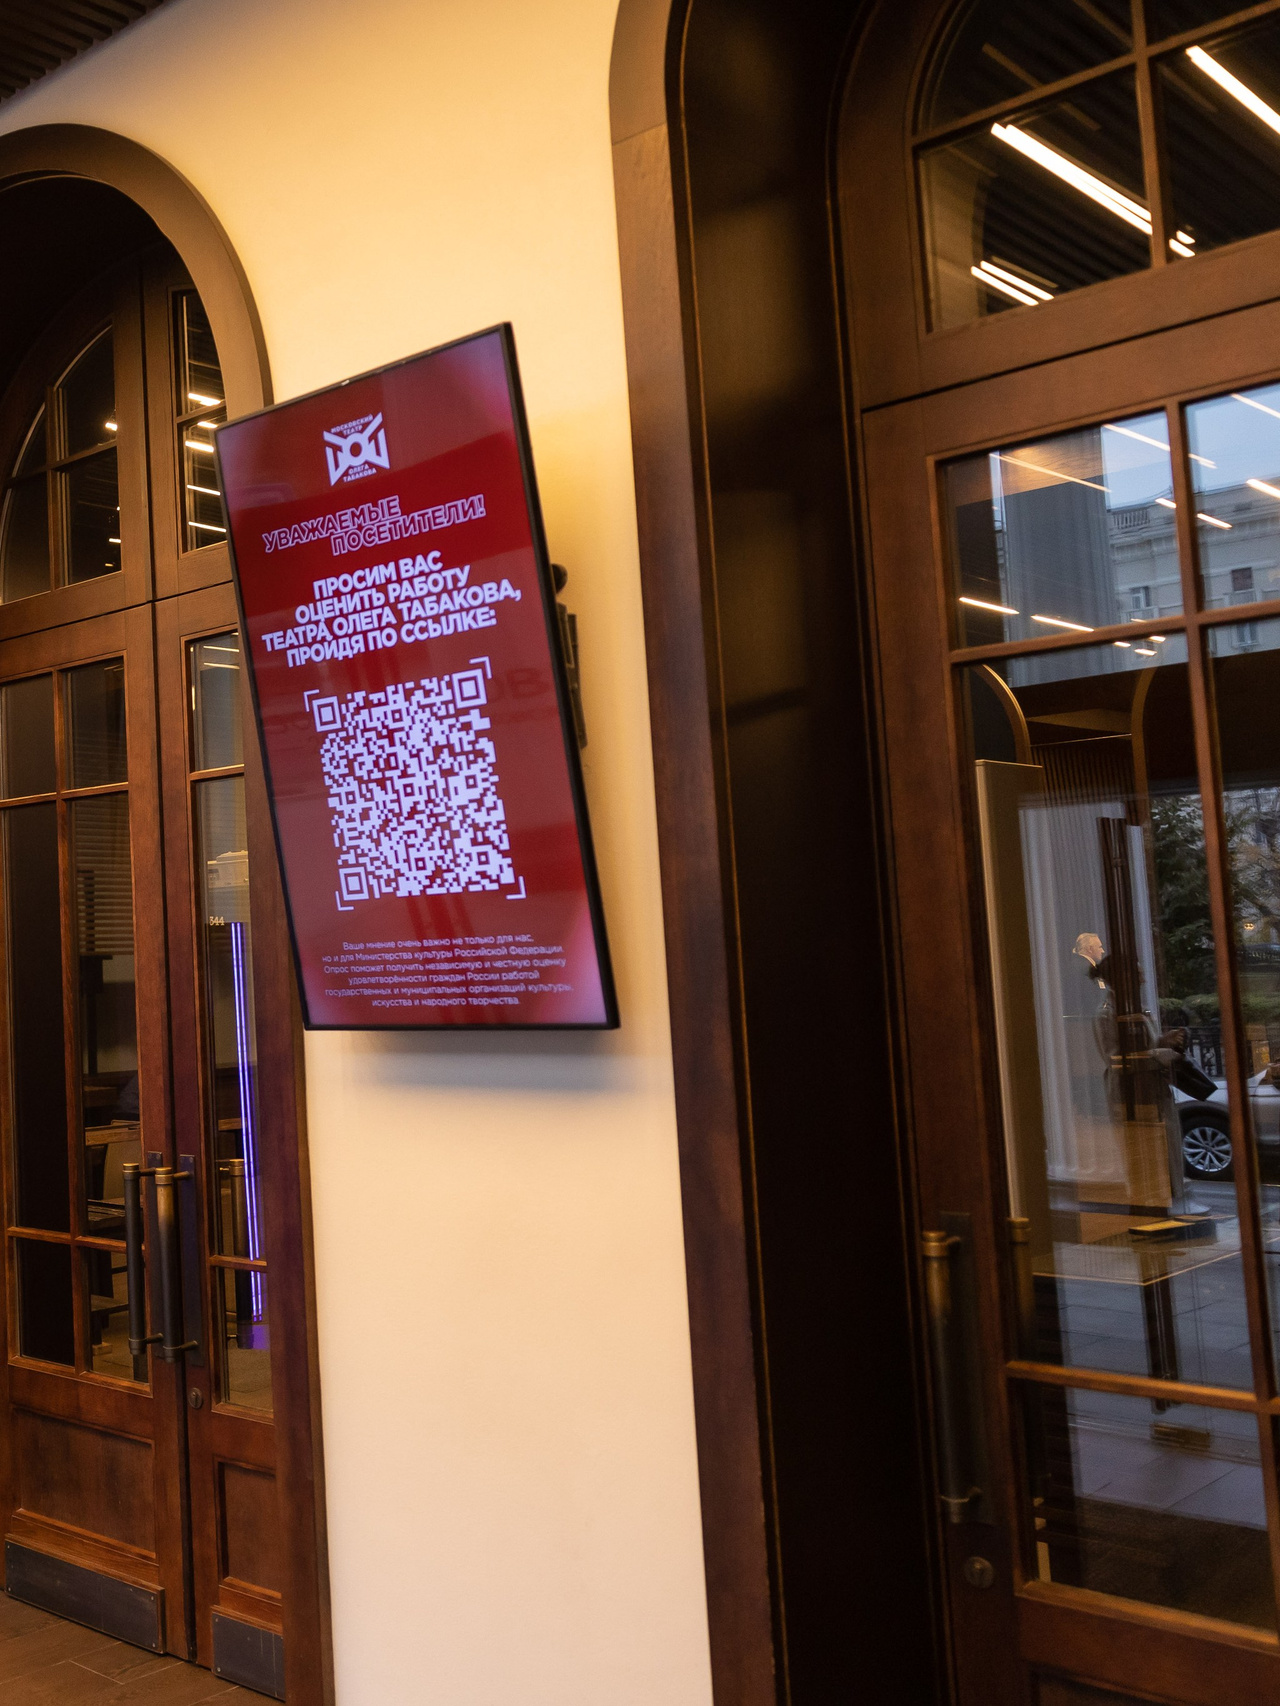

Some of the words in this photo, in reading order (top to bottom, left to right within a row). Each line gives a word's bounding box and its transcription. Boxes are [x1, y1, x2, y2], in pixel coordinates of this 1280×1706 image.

[331, 414, 373, 433] МОСКОВСКИЙ
[343, 425, 363, 436] ТЕАТР
[343, 468, 377, 482] ТАБАКОВА
[348, 464, 369, 474] ОЛЕГА
[262, 495, 401, 553] УВАЖАЕМЫЕ
[330, 495, 486, 556] ПОСЕТИТЕЛИ!
[313, 561, 397, 599] ПРОСИМ
[399, 550, 443, 578] ВАС
[295, 588, 385, 624] ОЦЕНИТЬ
[387, 565, 470, 603] РАБОТУ
[261, 623, 331, 651] ТЕАТРА
[333, 606, 396, 636] ОЛЕГА
[397, 579, 522, 622] ТАБАКОВА,
[286, 635, 365, 668] ПРОЙДЯ
[367, 628, 397, 651] ПО
[400, 606, 497, 644] ССЫЛКЕ:
[343, 941, 364, 951] Ваше
[366, 941, 396, 949] мнение
[397, 940, 422, 948] очень
[423, 939, 450, 947] важно
[464, 936, 495, 945] только
[496, 935, 513, 944] для
[340, 954, 355, 963] для
[355, 951, 412, 961] Министерства
[414, 950, 453, 961] культуры
[454, 947, 508, 957] Российской
[324, 965, 349, 974] Опрос
[350, 964, 384, 973] поможет
[386, 963, 424, 973] получить
[425, 961, 482, 971] независимую
[492, 959, 531, 969] честную
[532, 958, 566, 968] оценку
[429, 974, 466, 983] граждан
[466, 971, 500, 981] России
[501, 970, 540, 981] работой
[325, 988, 391, 997] государственных
[401, 986, 467, 996] муниципальных
[468, 983, 526, 994] организаций
[372, 999, 412, 1008] искусства
[421, 998, 467, 1007] народного
